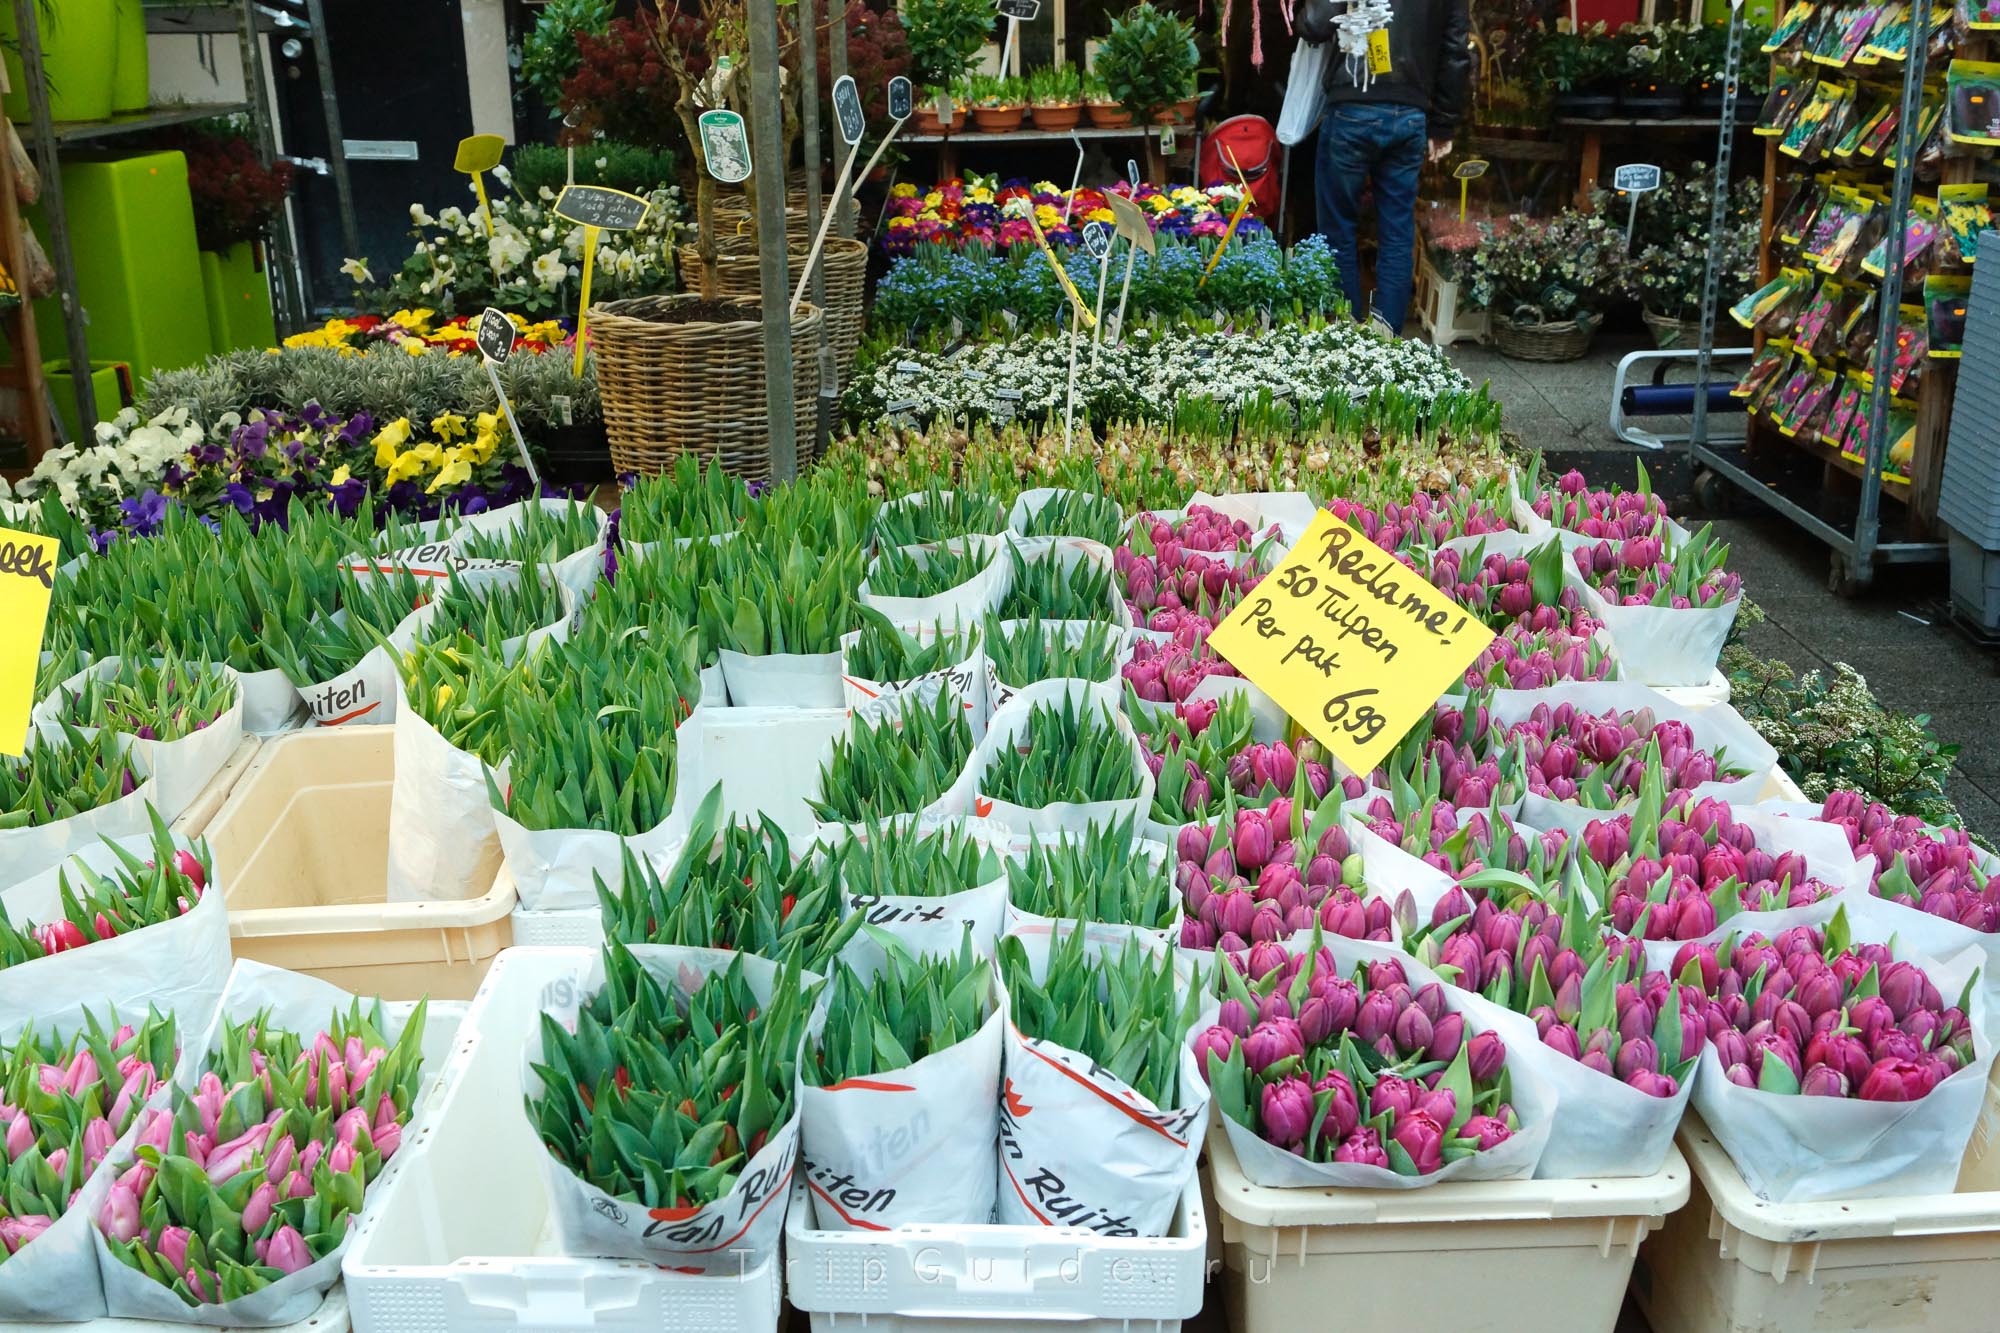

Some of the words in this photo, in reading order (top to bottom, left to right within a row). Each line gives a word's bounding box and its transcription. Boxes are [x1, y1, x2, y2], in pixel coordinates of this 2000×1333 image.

[1277, 564, 1318, 597] 50
[1316, 585, 1399, 664] Tulpen
[1319, 527, 1468, 645] Reclame!
[1280, 634, 1341, 678] pak
[642, 1211, 725, 1245] Van
